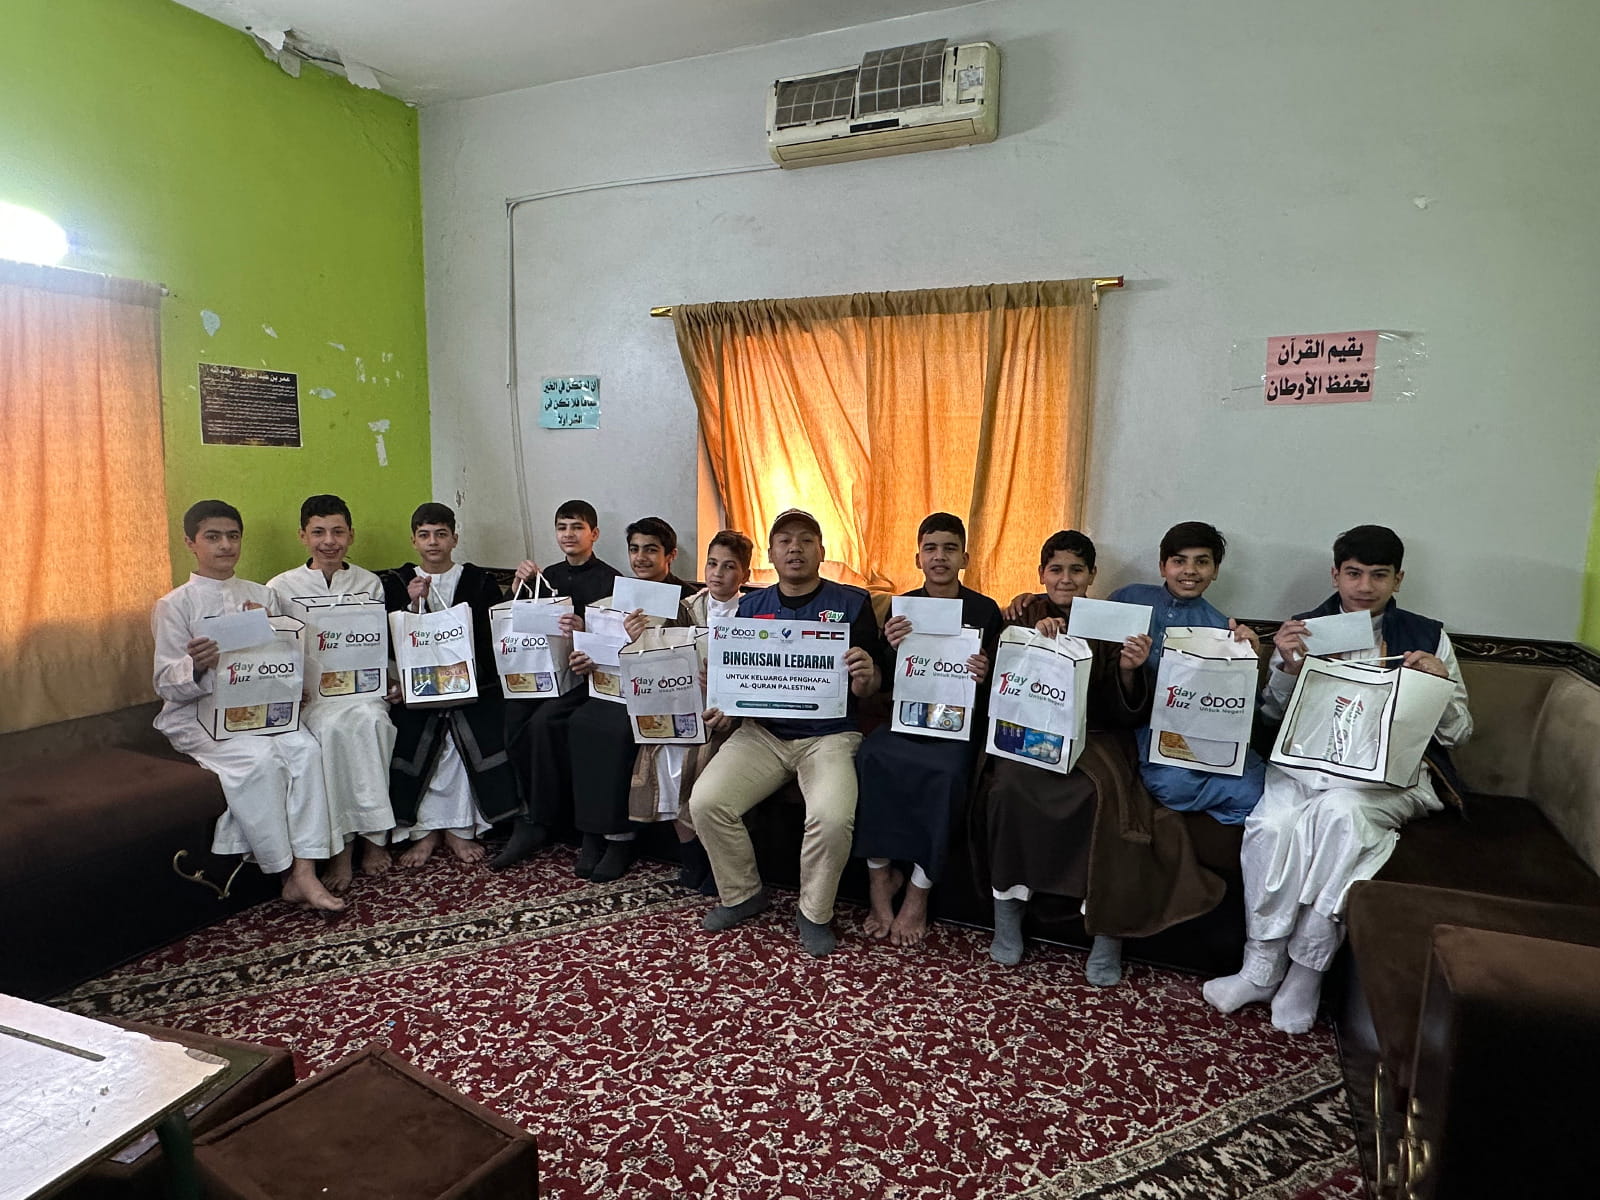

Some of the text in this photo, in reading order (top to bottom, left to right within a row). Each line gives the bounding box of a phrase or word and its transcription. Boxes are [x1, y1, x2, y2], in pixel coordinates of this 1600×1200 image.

[1277, 336, 1363, 365] بقيم القرآن
[1266, 371, 1371, 401] تحفظ الأوطان
[544, 398, 553, 411] في
[553, 397, 570, 410] تكن
[324, 631, 341, 640] day
[346, 632, 380, 643] ODOJ
[415, 630, 430, 638] day
[322, 641, 339, 651] juz
[416, 639, 429, 647] juz
[521, 636, 548, 647] ODO
[505, 646, 517, 655] juz
[723, 651, 835, 670] BINGKISAN LEBARAN
[911, 655, 930, 666] day
[235, 662, 254, 673] day
[258, 662, 294, 674] ODOJ
[909, 667, 926, 677] juz
[233, 675, 251, 685] juz
[638, 677, 654, 686] day
[658, 676, 693, 689] ODOJ
[1007, 672, 1027, 686] day
[637, 687, 652, 696] juz
[1002, 685, 1021, 696] juz
[1030, 681, 1066, 701] ODOJ
[1174, 686, 1197, 700] day
[1170, 698, 1190, 710] juz
[1200, 694, 1246, 709] ODOJ
